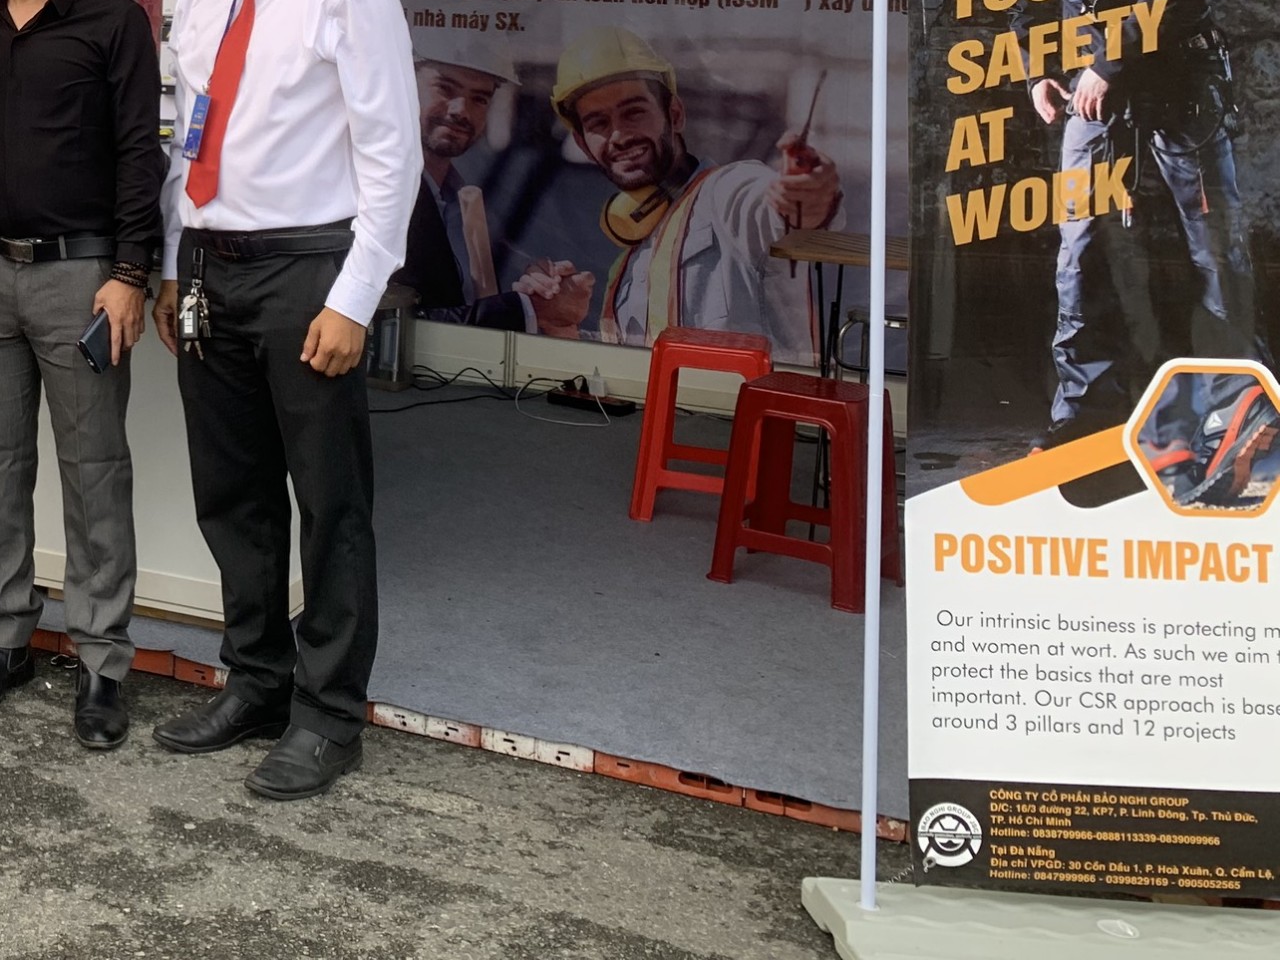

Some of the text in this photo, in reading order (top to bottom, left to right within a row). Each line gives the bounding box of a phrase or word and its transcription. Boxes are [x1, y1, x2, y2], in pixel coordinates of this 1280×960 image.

[413, 9, 525, 32] nhà máy SX.
[945, 106, 1014, 173] AT
[945, 157, 1134, 247] WORK
[933, 532, 1274, 584] POSITIVE IMPACT
[936, 609, 974, 627] Our
[980, 611, 1052, 631] intrinsic
[1058, 613, 1136, 634] business
[1142, 617, 1157, 634] is
[1163, 621, 1256, 642] protecting
[931, 635, 965, 653] and
[972, 641, 1040, 656] women
[1047, 642, 1065, 656] at
[1071, 643, 1117, 659] wort.
[1124, 642, 1147, 660] As
[1153, 643, 1195, 661] such
[1202, 649, 1229, 663] we
[1235, 646, 1270, 664] aim
[931, 662, 1224, 688] protect the basics that are most
[931, 686, 1236, 716] important. Our CSR approach is
[932, 712, 1237, 743] around 3 pillars and 12 projects
[989, 788, 1022, 801] CÔNG
[1025, 791, 1039, 801] TY
[1120, 795, 1148, 806] NGHI
[1150, 796, 1190, 807] GROUP
[1016, 803, 1037, 813] 16/3
[990, 827, 1030, 838] Hotline:
[1045, 817, 1072, 827] Minh
[990, 870, 1031, 880] Hotline:
[1030, 859, 1066, 870] VPGD:
